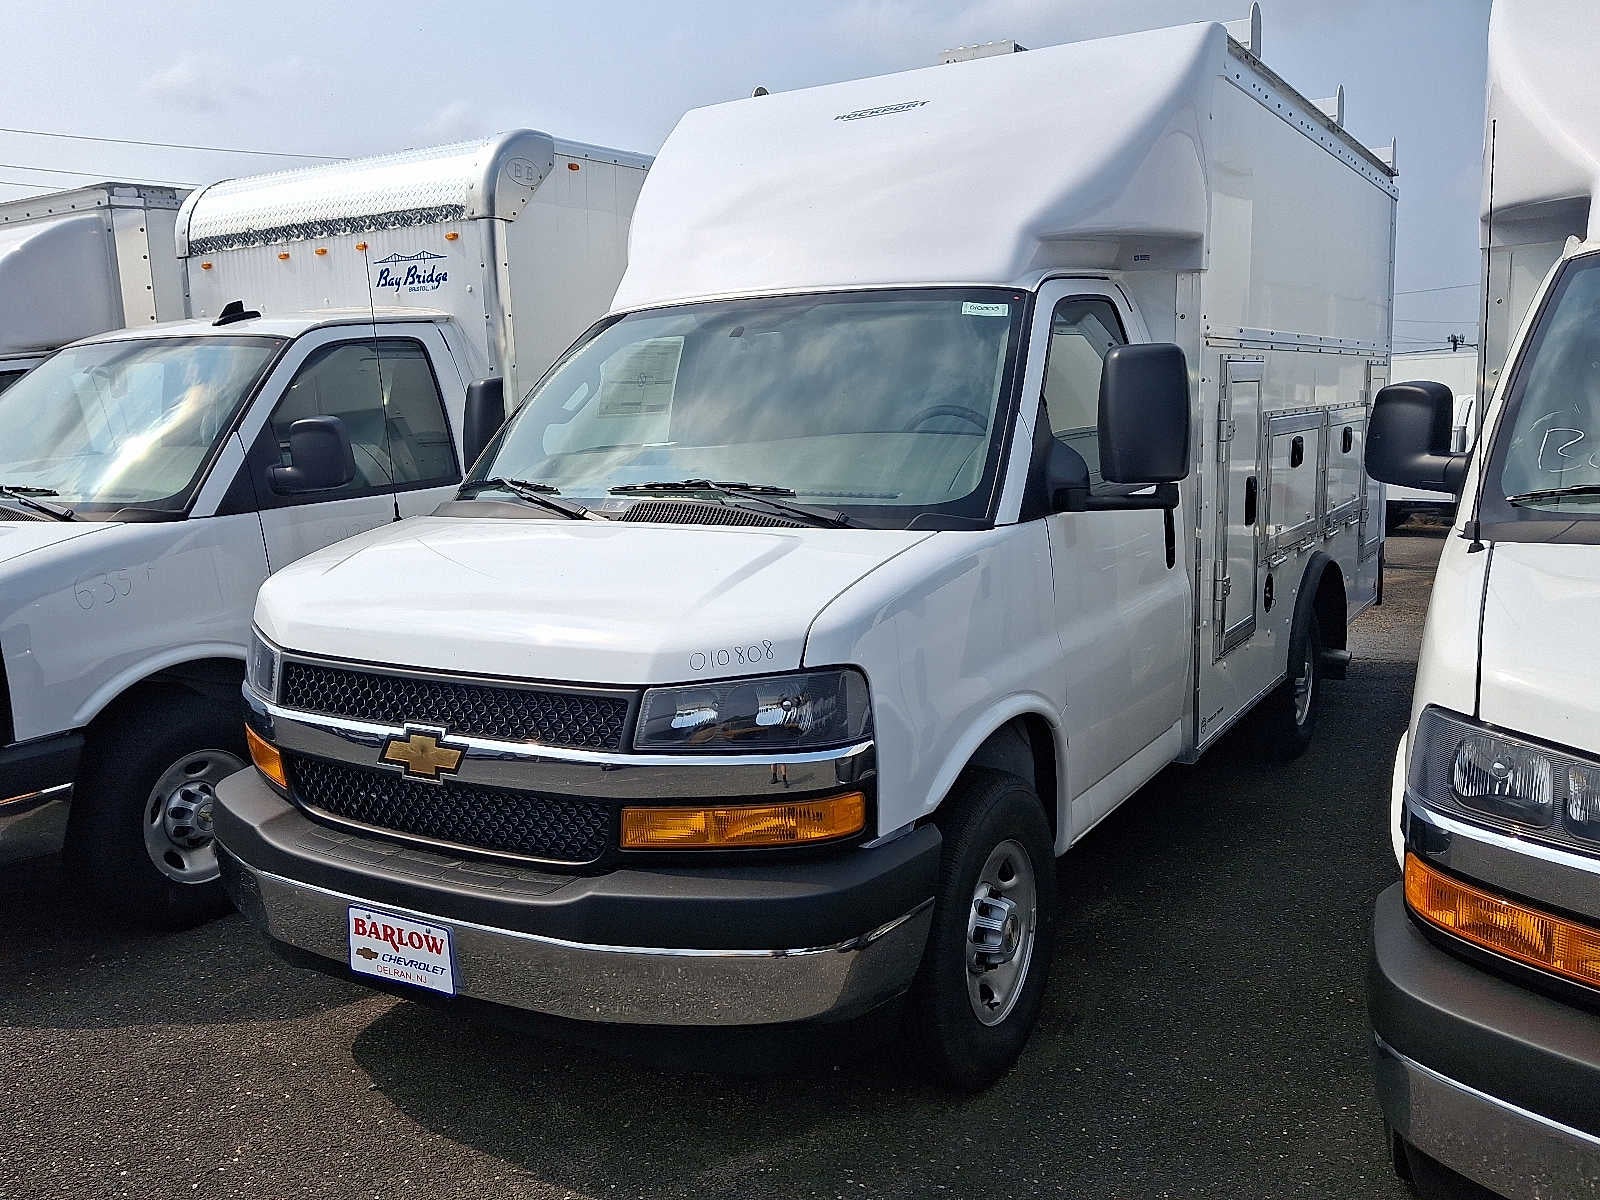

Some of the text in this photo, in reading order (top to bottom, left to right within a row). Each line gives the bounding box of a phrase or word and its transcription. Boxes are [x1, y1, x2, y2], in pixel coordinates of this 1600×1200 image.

[375, 264, 448, 292] Bay Bridge
[689, 639, 774, 671] 010808
[353, 917, 445, 956] BARLOW
[381, 953, 447, 976] CHEVROLET
[416, 974, 428, 985] NJ
